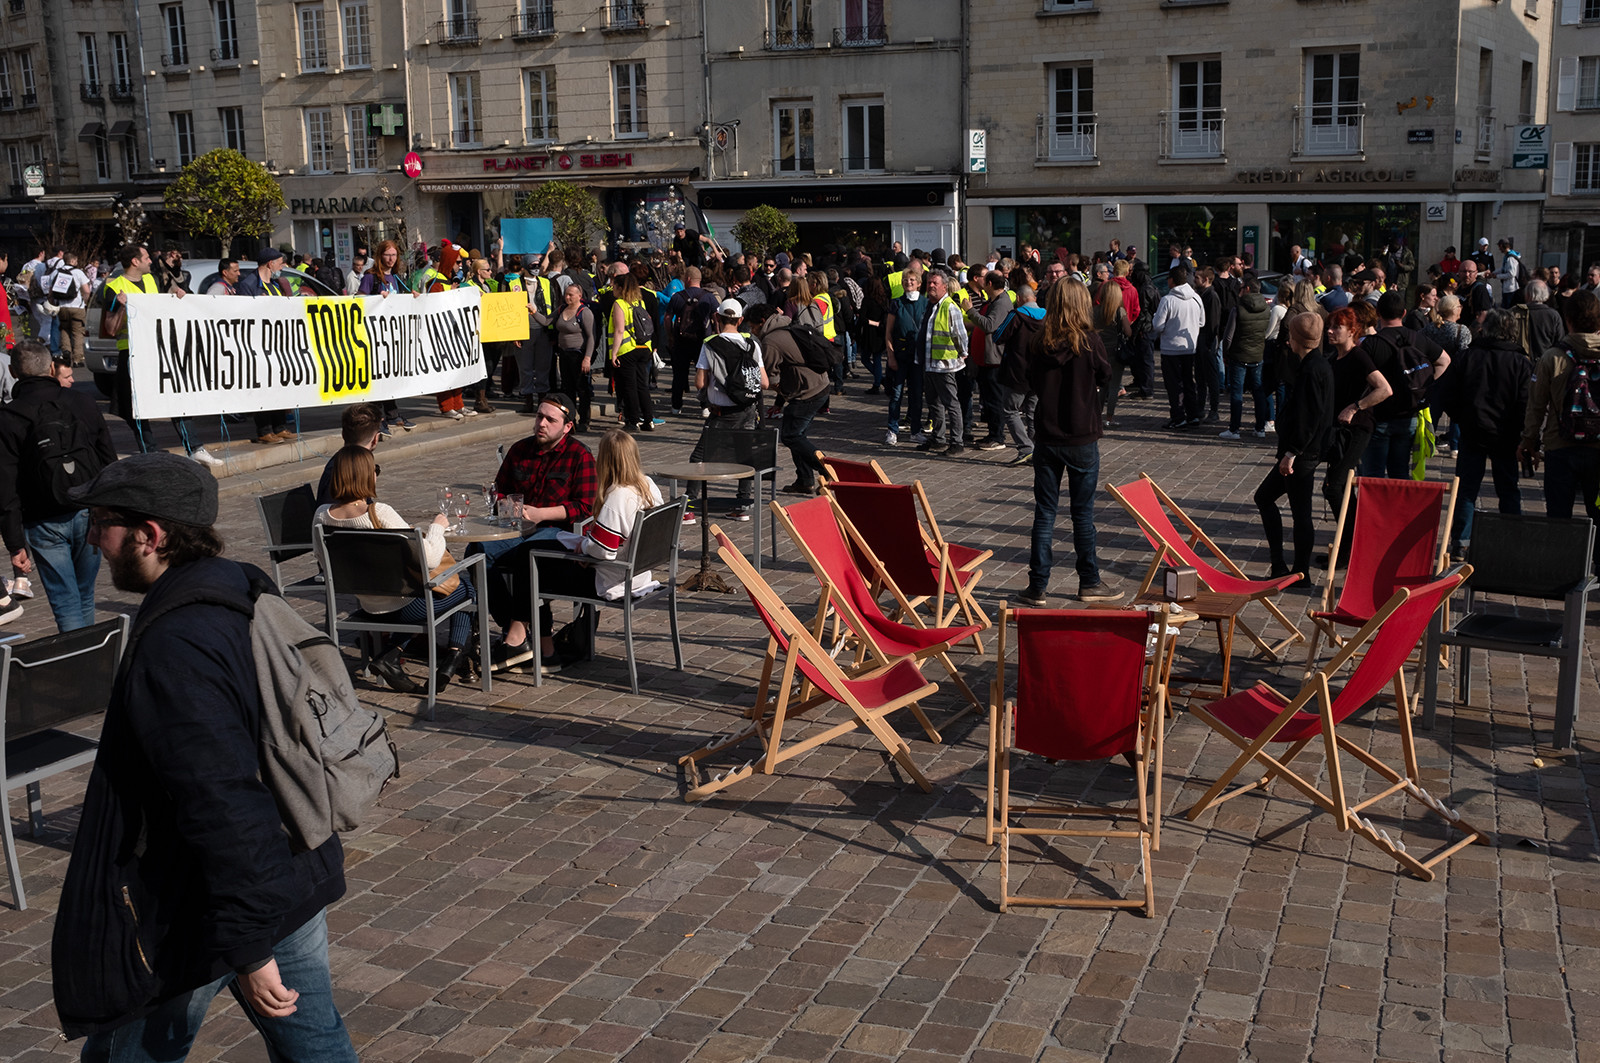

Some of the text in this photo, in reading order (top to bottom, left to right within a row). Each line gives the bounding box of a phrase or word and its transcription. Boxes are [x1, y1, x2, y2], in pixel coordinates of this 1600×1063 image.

[483, 152, 632, 171] PLANET SUSHI
[1313, 168, 1417, 183] AGRICOLE
[156, 303, 481, 394] AMNISTIE POUR TOUS LES GILETS JAUNES
